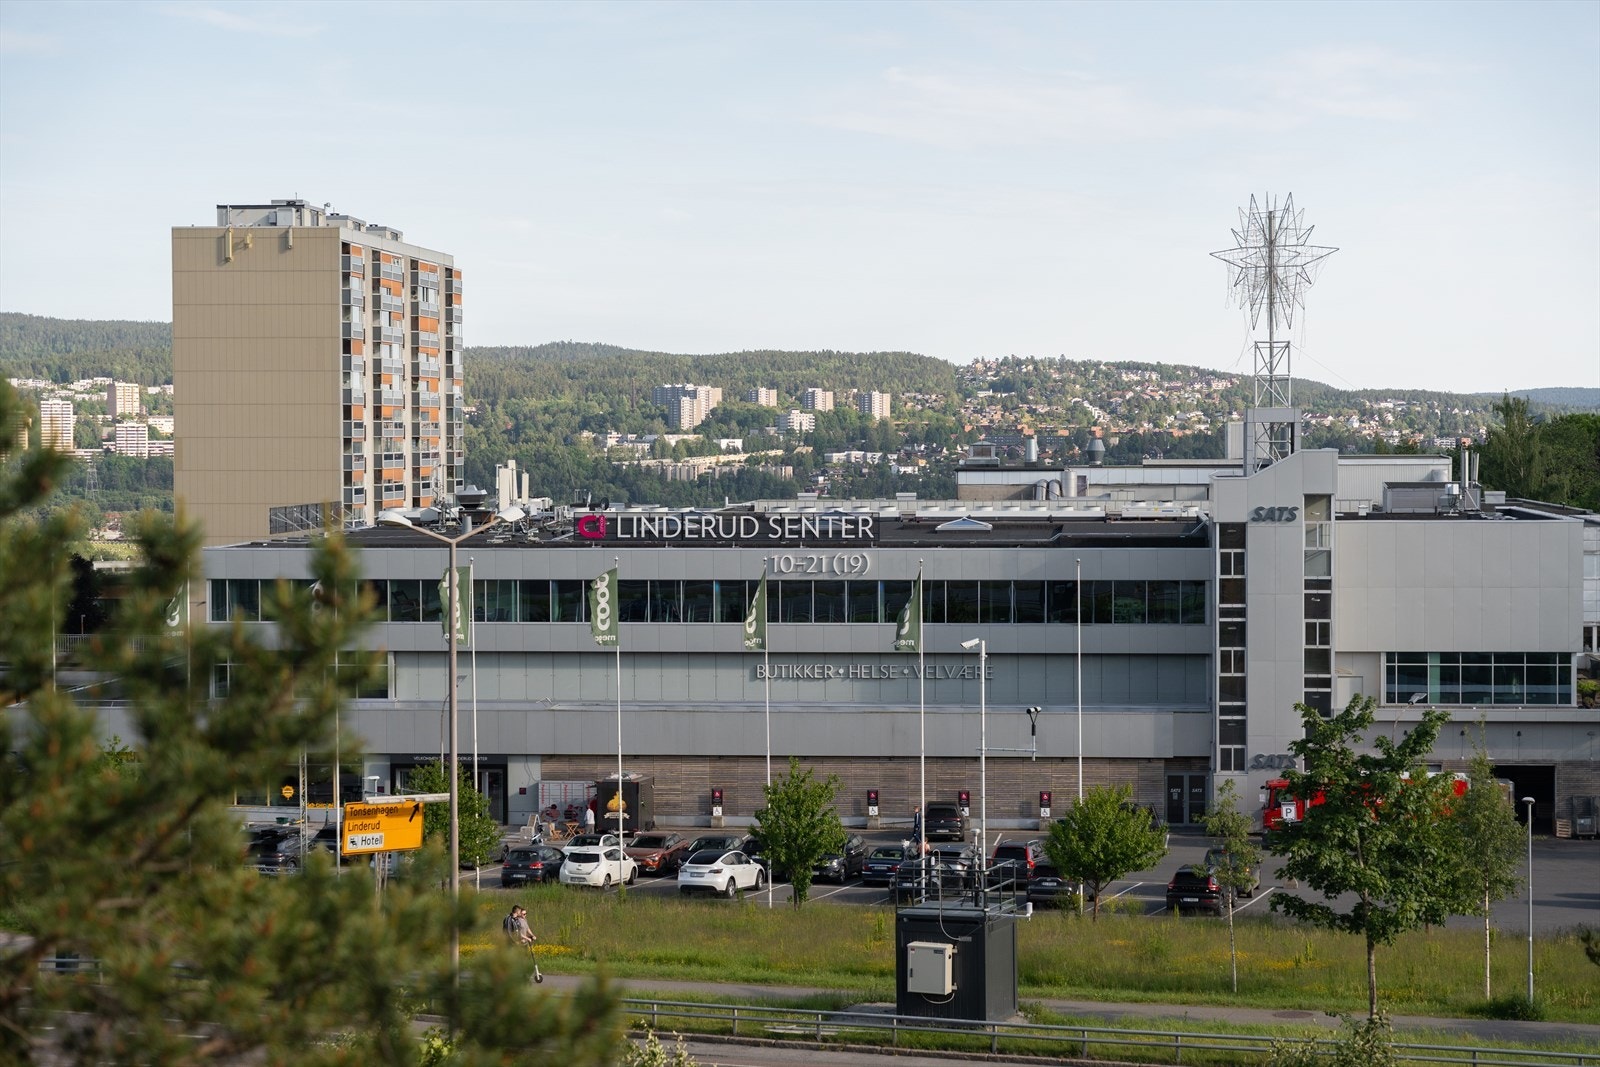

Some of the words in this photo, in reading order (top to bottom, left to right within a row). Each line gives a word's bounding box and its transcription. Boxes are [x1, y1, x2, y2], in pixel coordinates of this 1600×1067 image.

[1251, 506, 1299, 522] SATS
[617, 515, 760, 539] LINDERUD
[768, 515, 875, 539] SENTER
[833, 552, 871, 576] (19)
[756, 664, 834, 679] BUTIKKER
[849, 664, 898, 679] HELSE
[1251, 753, 1297, 770] SATS
[349, 806, 399, 817] Tonsenhagen
[1285, 807, 1292, 817] P
[347, 820, 381, 832] Linderud
[360, 834, 384, 846] Hotell
